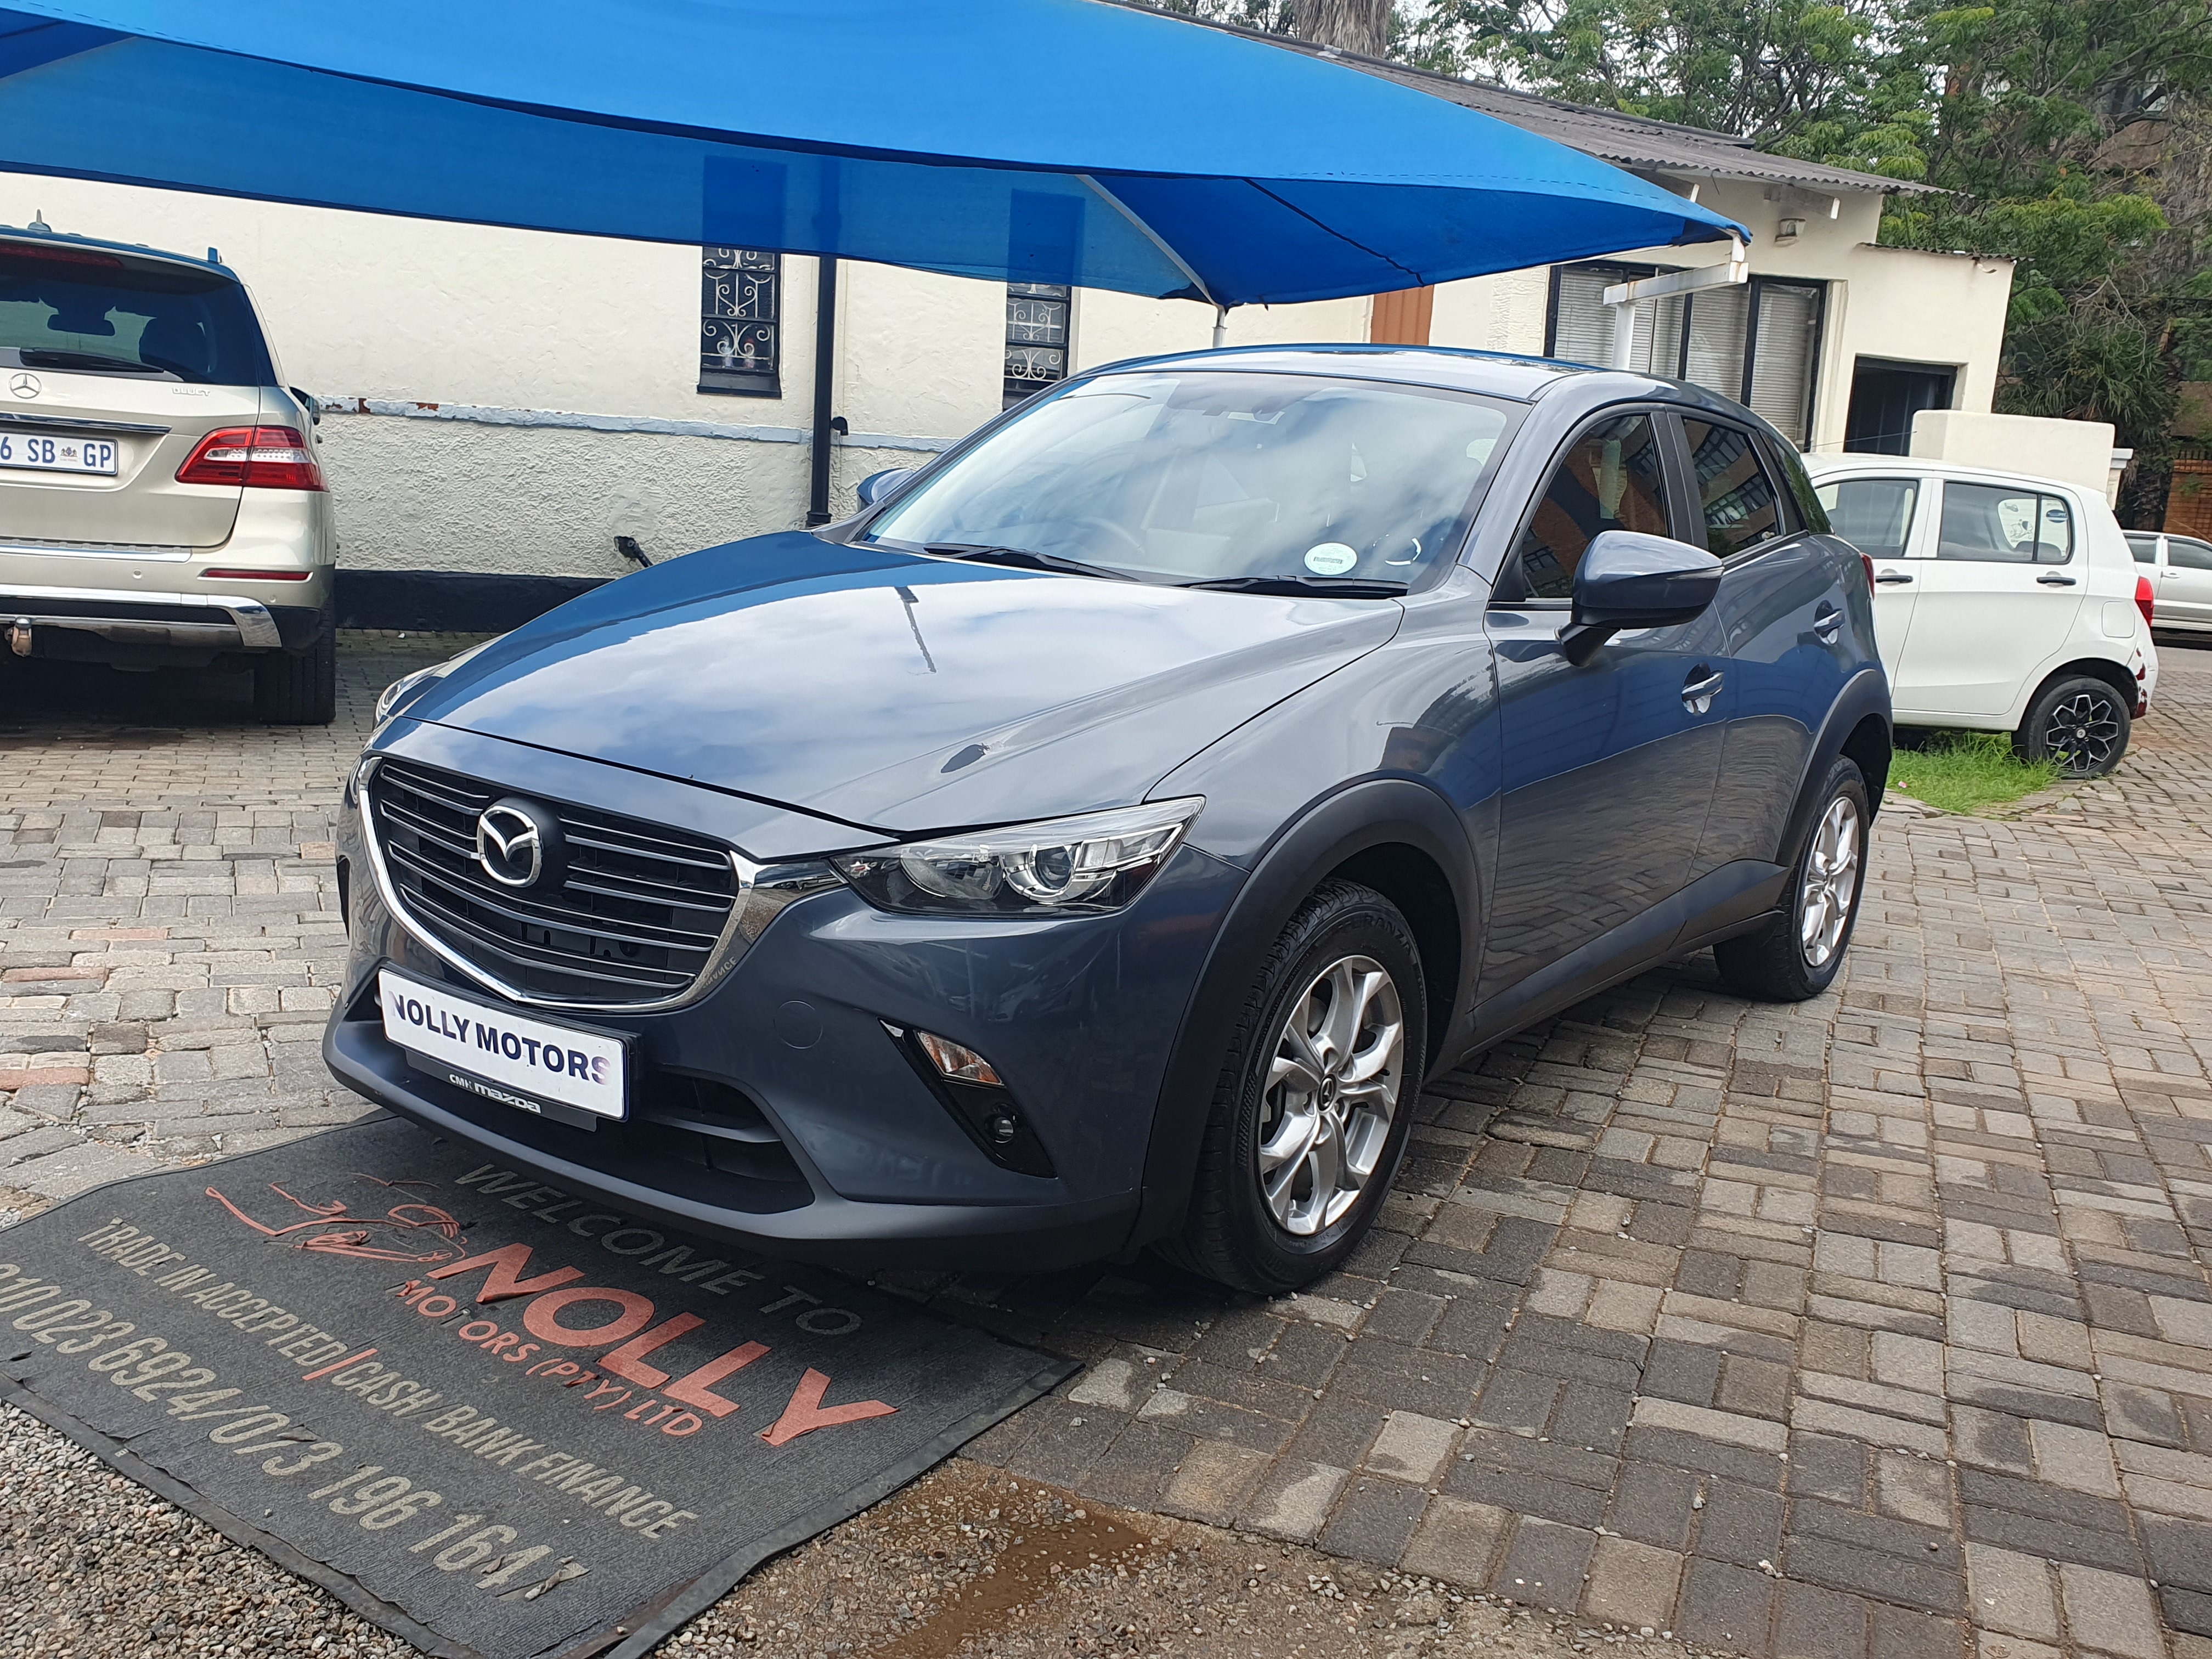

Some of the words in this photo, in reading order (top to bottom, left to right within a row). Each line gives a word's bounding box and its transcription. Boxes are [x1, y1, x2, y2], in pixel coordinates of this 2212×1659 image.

[27, 438, 55, 463] SB
[83, 443, 111, 467] GP
[389, 990, 470, 1043] NOLLY
[476, 1023, 611, 1085] MOTORS
[0, 1263, 61, 1312] 10
[454, 1164, 765, 1295] WELCOME
[759, 1285, 863, 1335] TO
[12, 1299, 136, 1354] 023
[426, 1243, 900, 1446] NOLLY
[77, 1217, 186, 1277] TRADE
[153, 1264, 217, 1292] IN
[514, 1452, 700, 1539] FINANCE
[525, 1358, 633, 1410] (PTY)
[623, 1400, 703, 1436] LTD
[308, 1465, 442, 1530] 196
